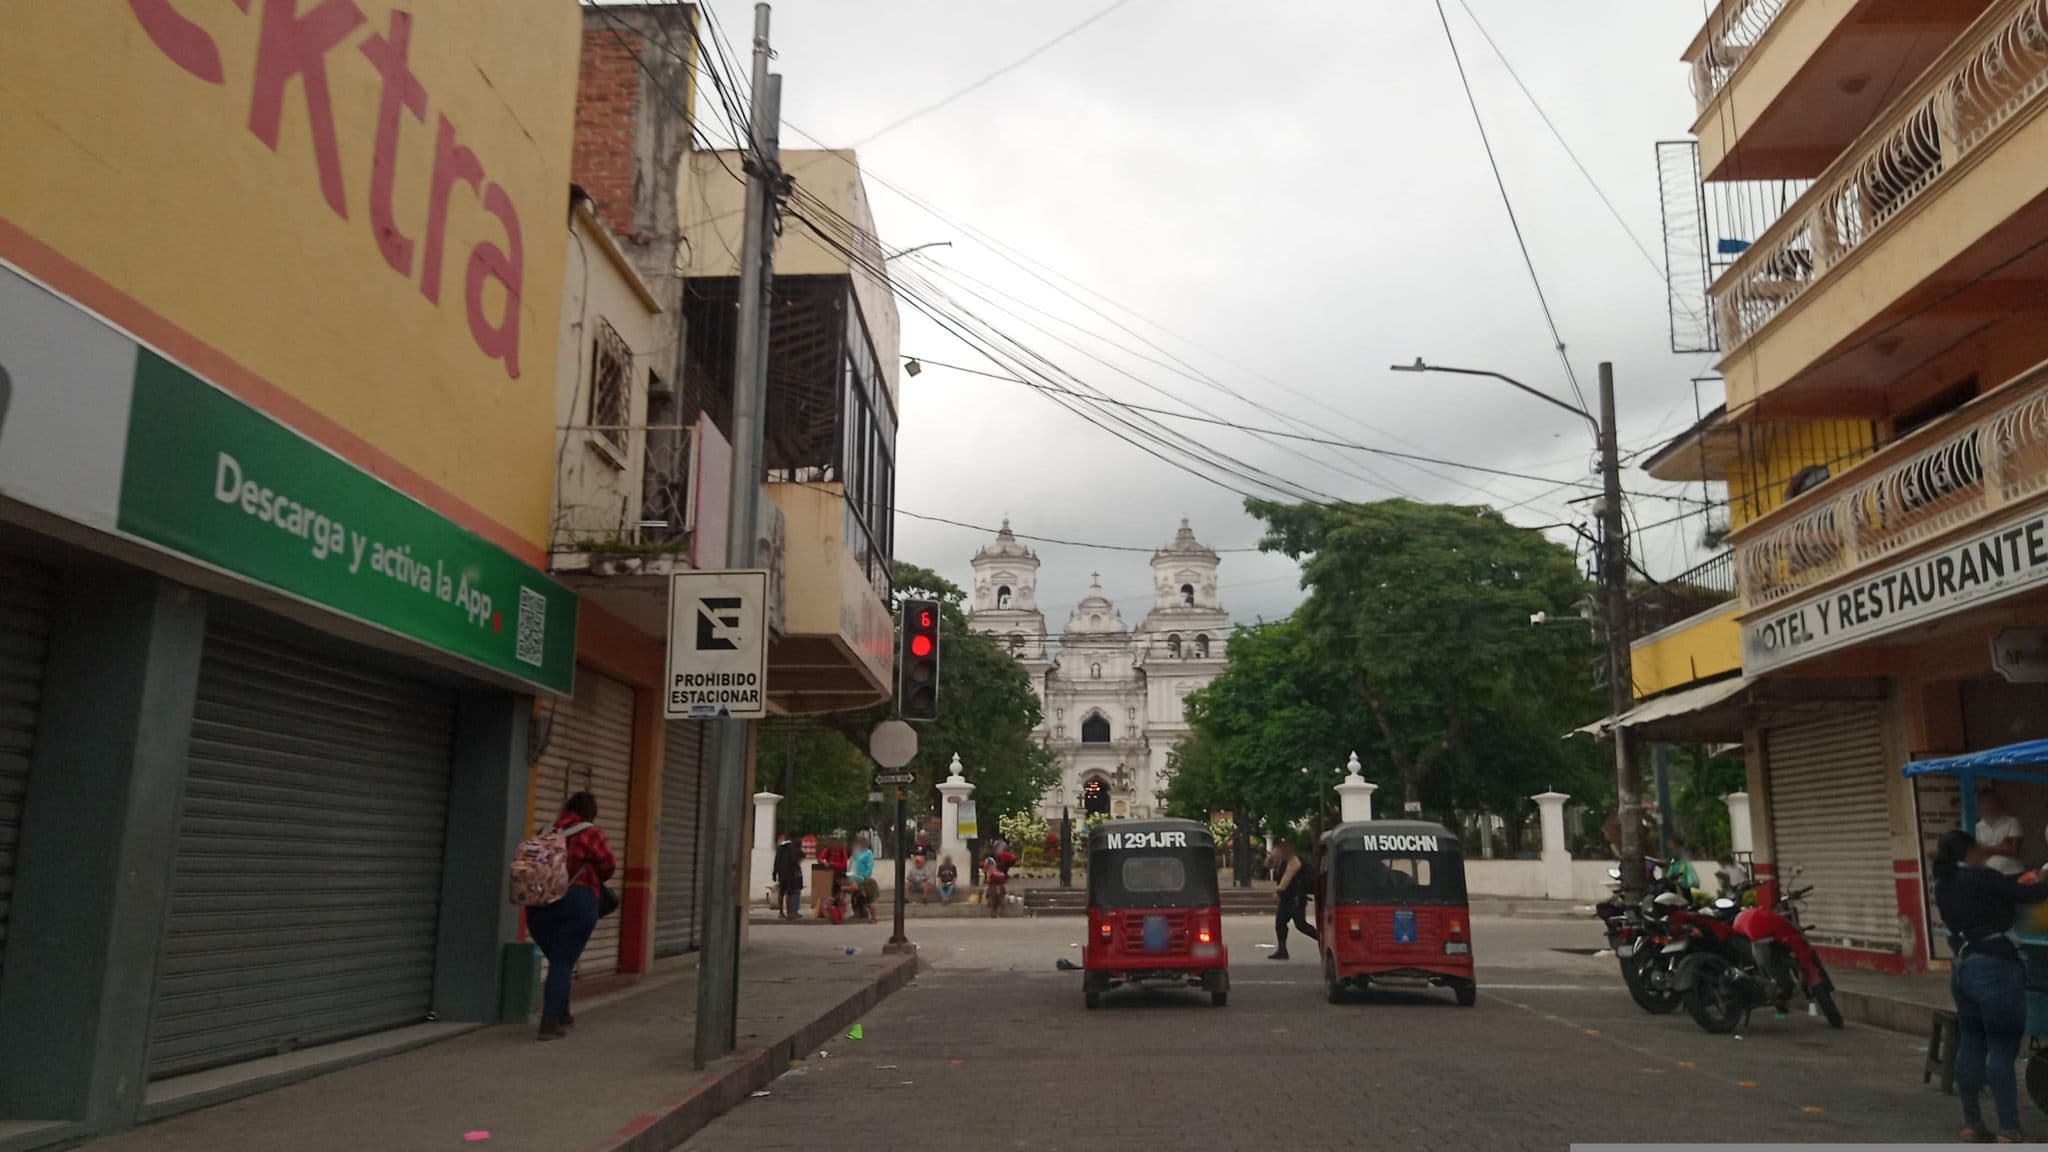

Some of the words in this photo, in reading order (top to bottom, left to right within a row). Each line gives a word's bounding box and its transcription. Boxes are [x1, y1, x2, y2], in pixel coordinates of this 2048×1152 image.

[215, 451, 345, 559] Descarga
[349, 530, 367, 574] y
[371, 542, 432, 593] activa
[436, 560, 452, 602] la
[1752, 609, 1813, 653] OTEL
[1816, 600, 1830, 635] Y
[1838, 519, 2048, 630] RESTAURANTE
[921, 612, 931, 627] 6
[675, 673, 757, 687] PROHIBIDO
[672, 690, 759, 704] ESTACIONAR
[1107, 833, 1122, 849] M
[1124, 831, 1187, 848] 291JFR
[1363, 835, 1378, 851] M
[1379, 835, 1439, 852] 500CHN
